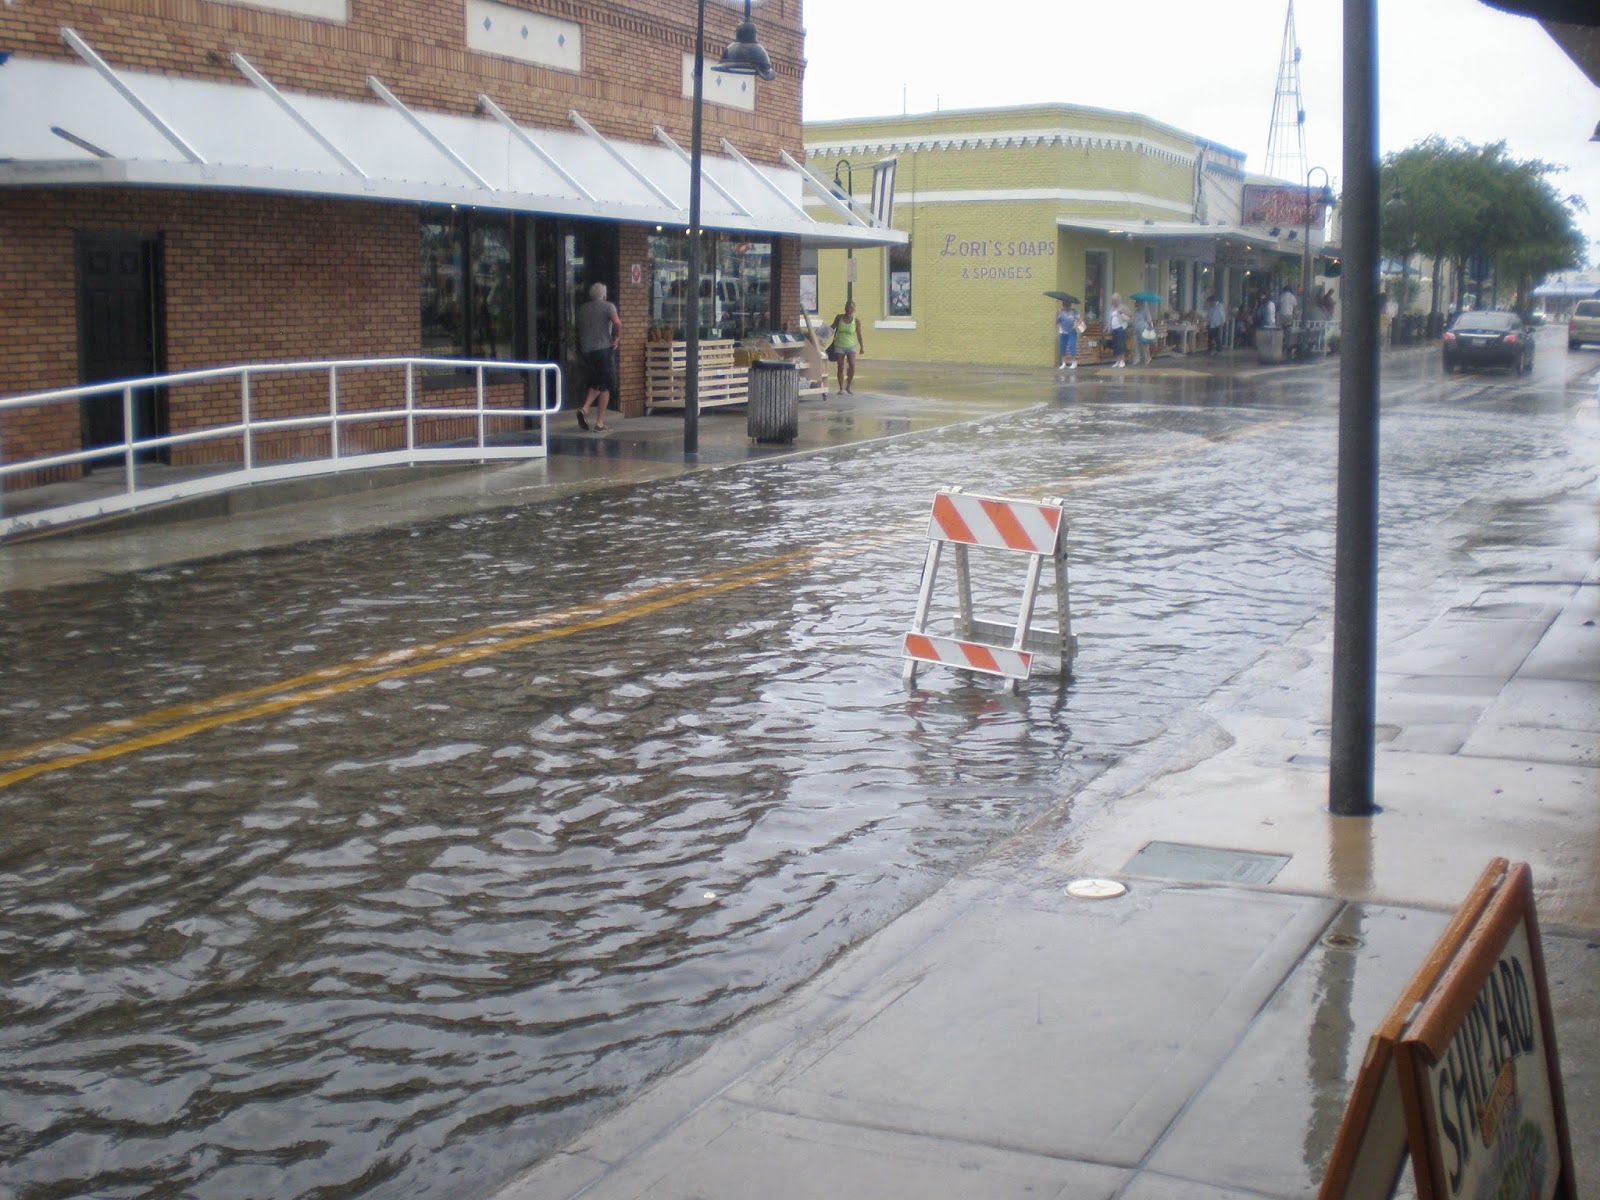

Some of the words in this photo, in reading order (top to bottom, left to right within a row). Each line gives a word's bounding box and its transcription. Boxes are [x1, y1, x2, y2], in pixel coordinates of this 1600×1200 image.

[940, 233, 1002, 256] LORI'S
[1007, 241, 1055, 256] SOAPS
[962, 267, 970, 279] &
[973, 266, 1033, 279] SPONGES
[1439, 955, 1534, 1196] SHIPYARD
